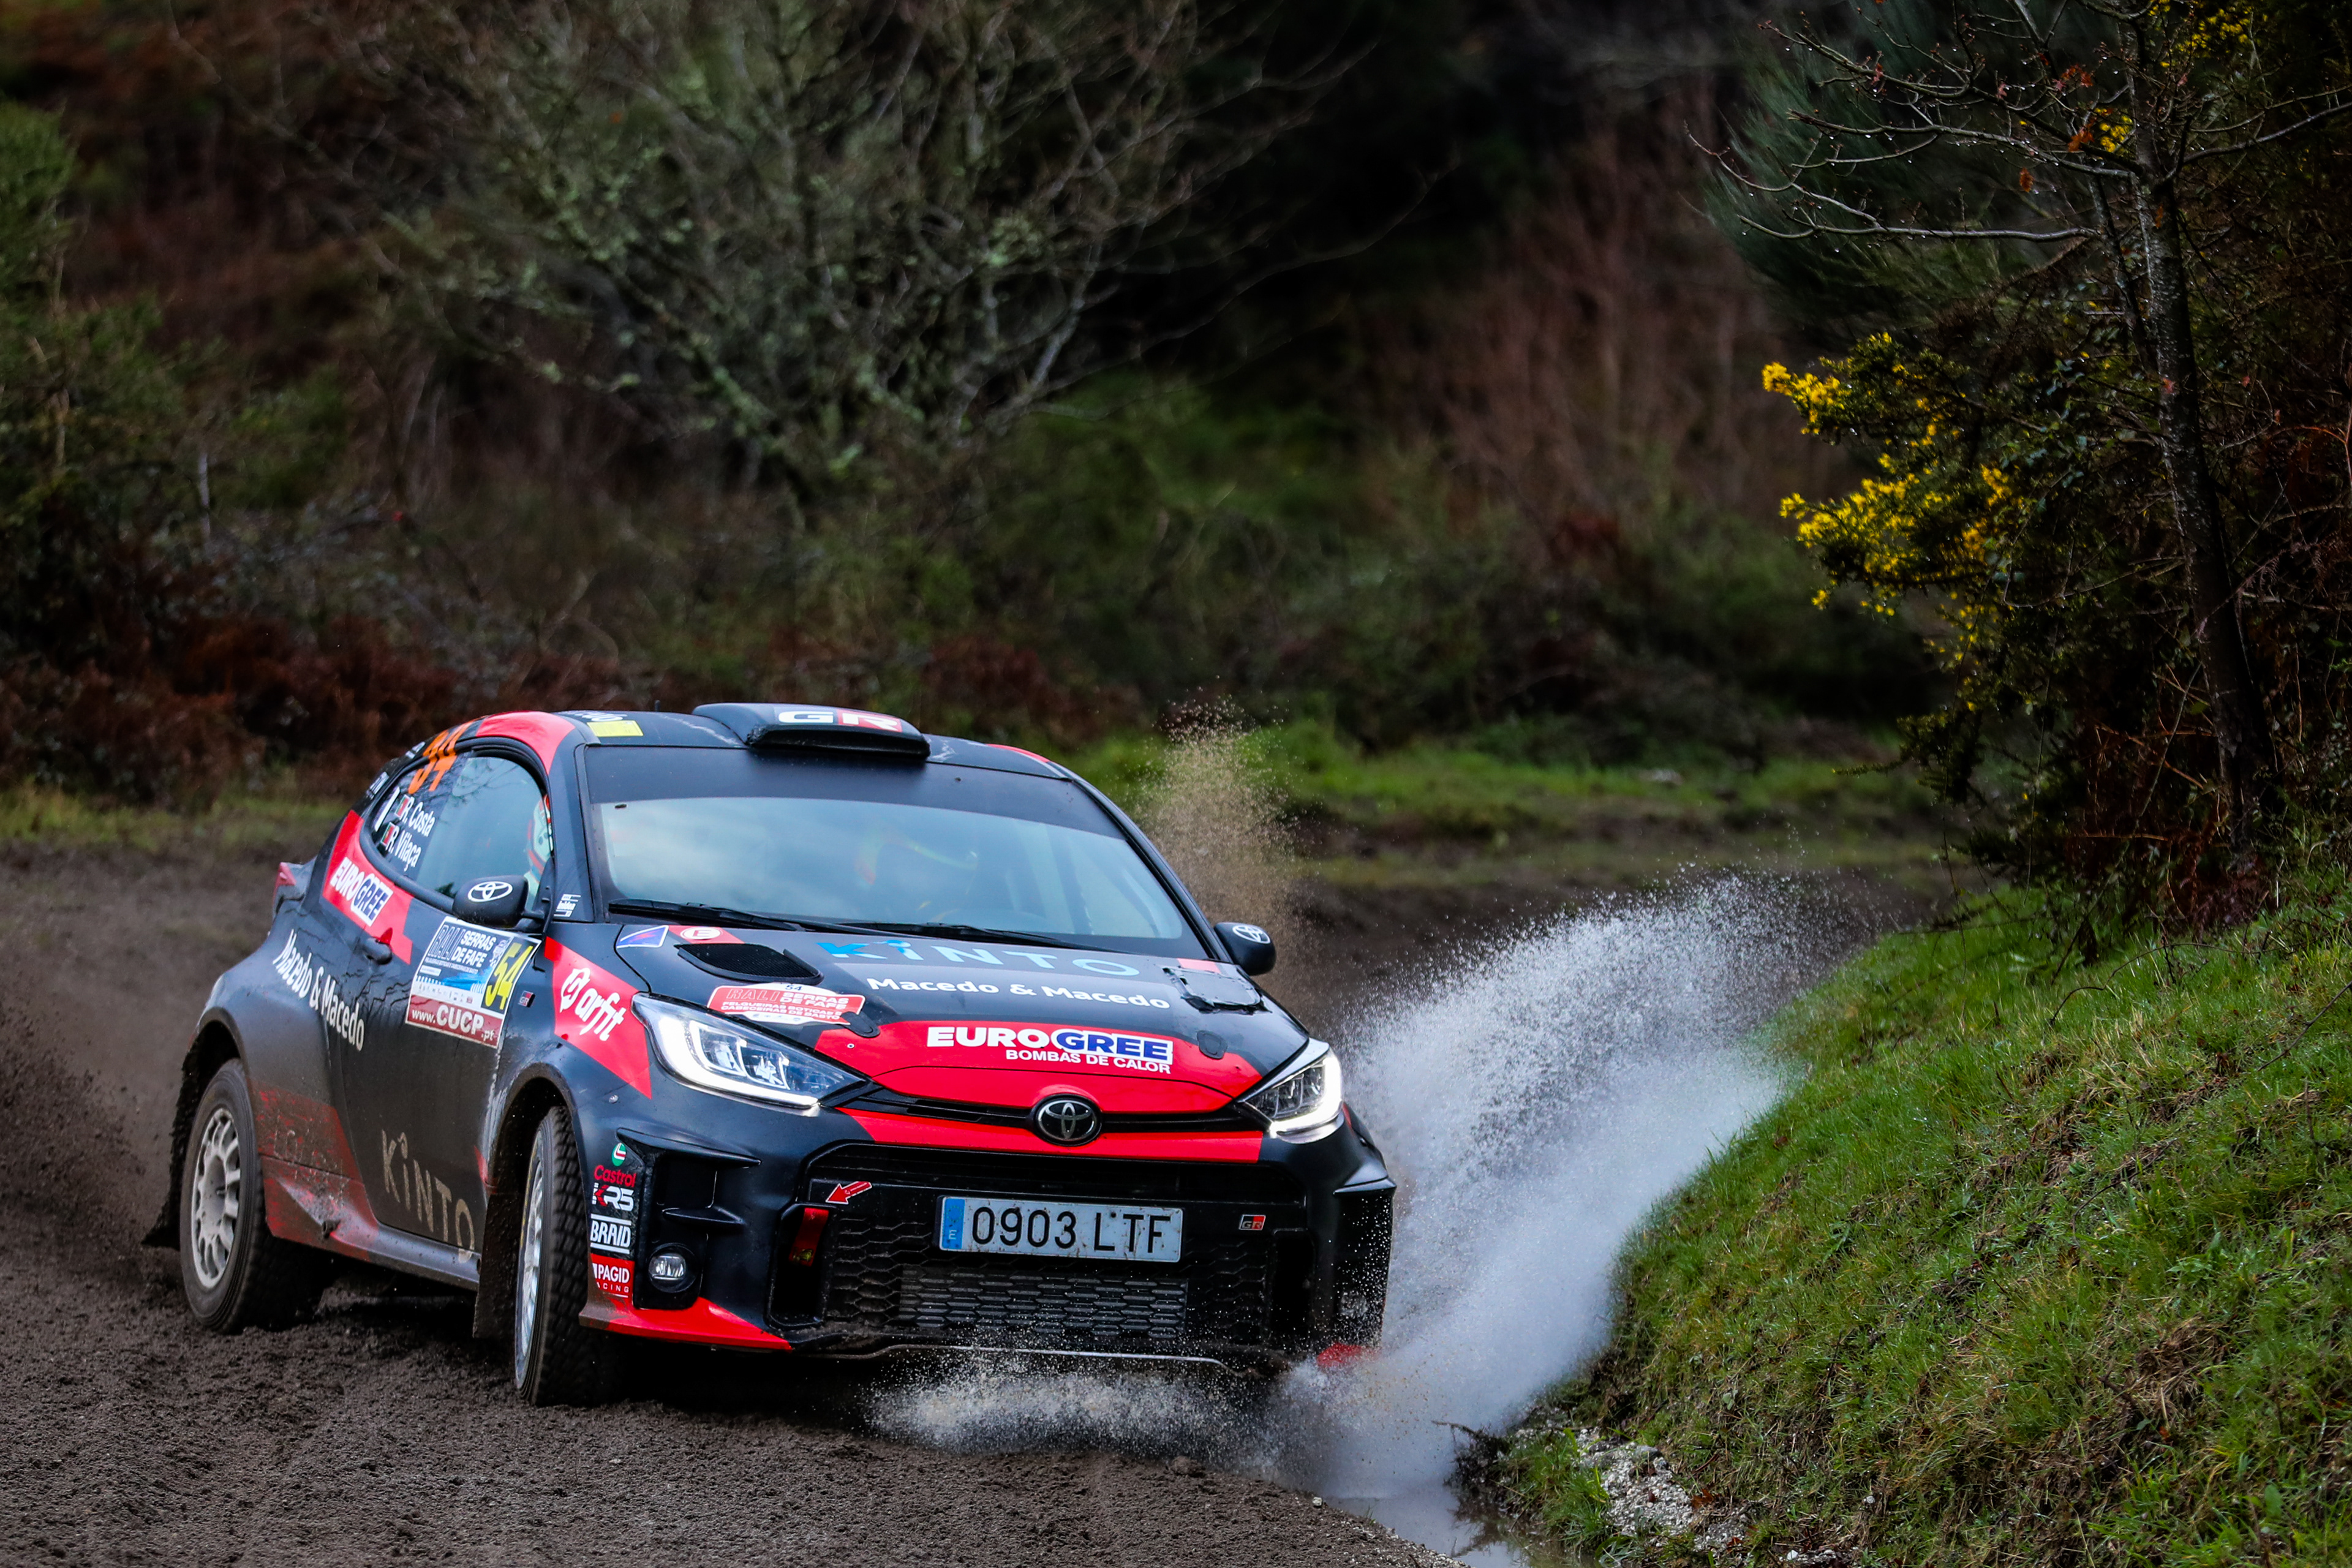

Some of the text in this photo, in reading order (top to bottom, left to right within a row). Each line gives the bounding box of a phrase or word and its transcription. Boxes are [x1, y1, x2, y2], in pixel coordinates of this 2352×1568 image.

[778, 711, 899, 731] GR
[399, 796, 435, 837] R. Costa
[386, 826, 422, 872] R. Vilaça
[330, 857, 391, 922] EUROGREE
[461, 930, 497, 951] SERRAS
[451, 946, 467, 963] DE
[462, 949, 488, 968] FAFE
[485, 943, 533, 1010] 54
[273, 929, 364, 1052] Macedo & Macedo
[726, 989, 850, 1005] RALI SERRAS
[867, 978, 1170, 1009] Macedo & Macedo
[788, 1005, 834, 1016] BOTICAS
[805, 999, 847, 1010] FAFE
[927, 1027, 1170, 1062] EUROGREE
[1006, 1049, 1171, 1074] BOMBAS DE CALOR
[594, 1165, 636, 1188] Castrol
[590, 1220, 631, 1248] BRAID
[948, 1229, 957, 1240] E
[972, 1207, 1170, 1253] 0903 LTF
[598, 1264, 630, 1284] PAGID
